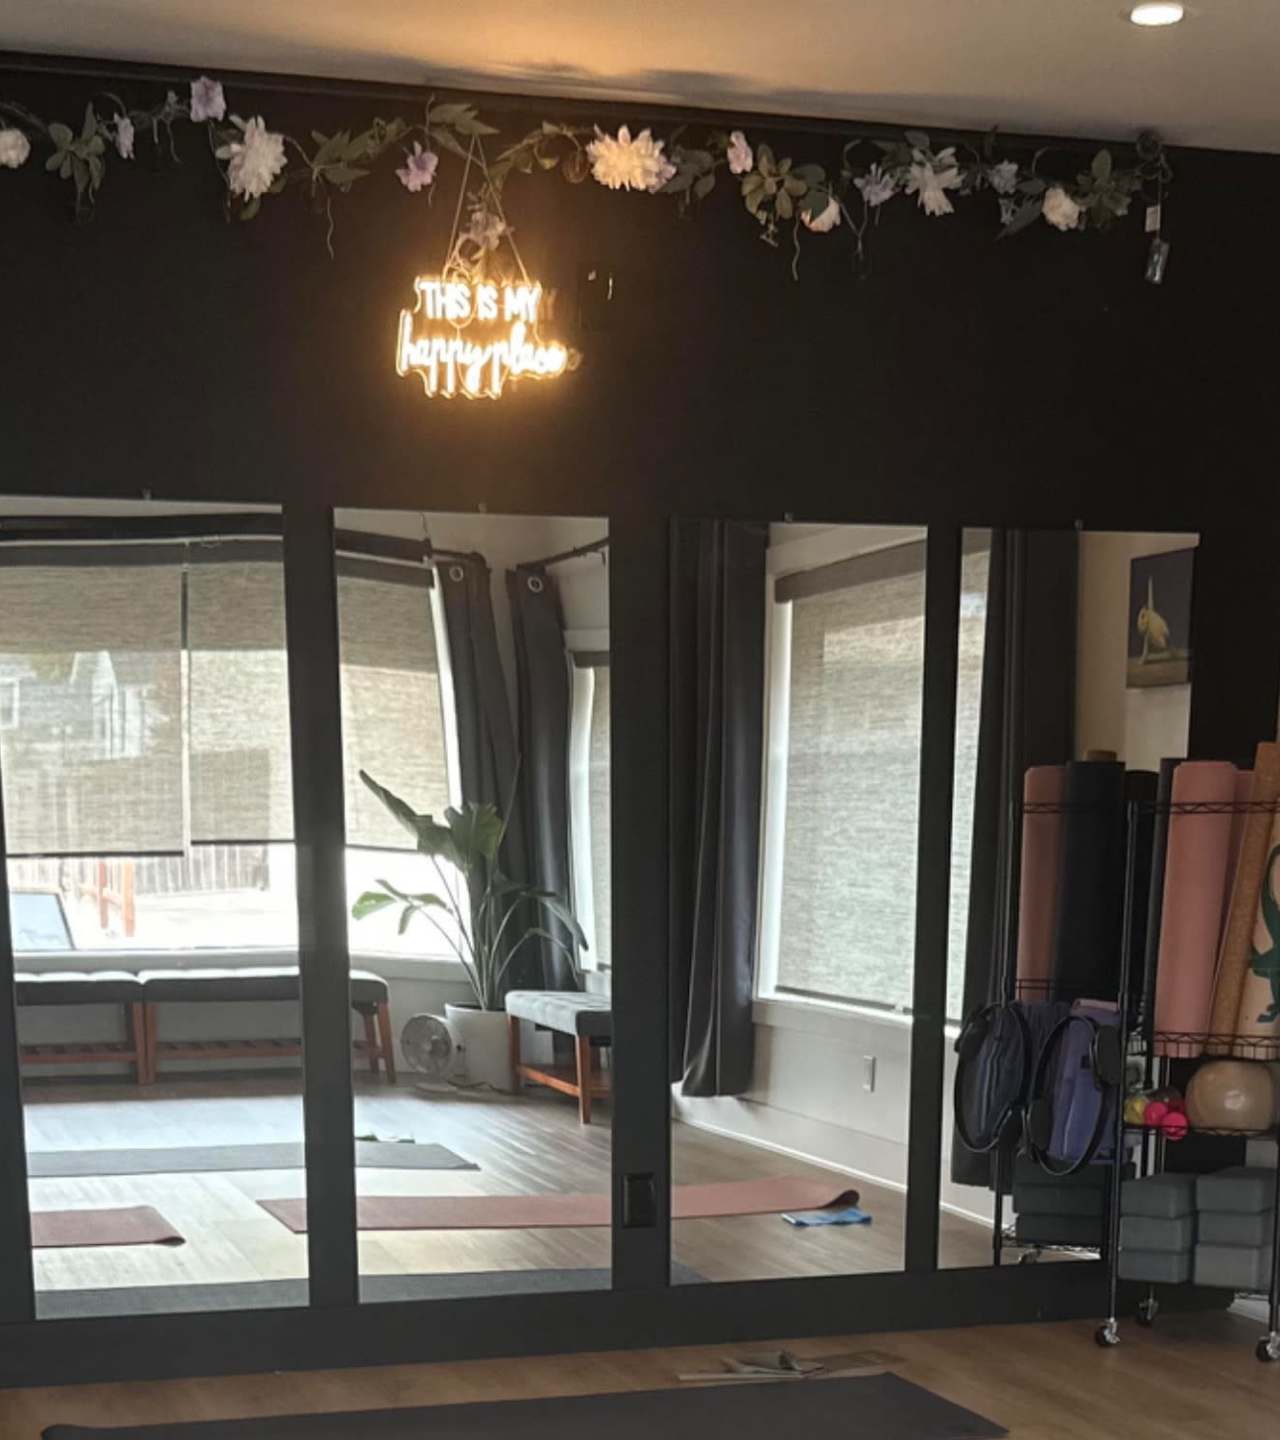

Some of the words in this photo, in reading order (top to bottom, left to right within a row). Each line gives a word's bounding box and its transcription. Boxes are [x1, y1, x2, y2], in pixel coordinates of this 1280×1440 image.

[419, 280, 471, 320] THIS
[477, 281, 498, 321] IS
[504, 282, 541, 323] MY
[399, 311, 487, 398] happy
